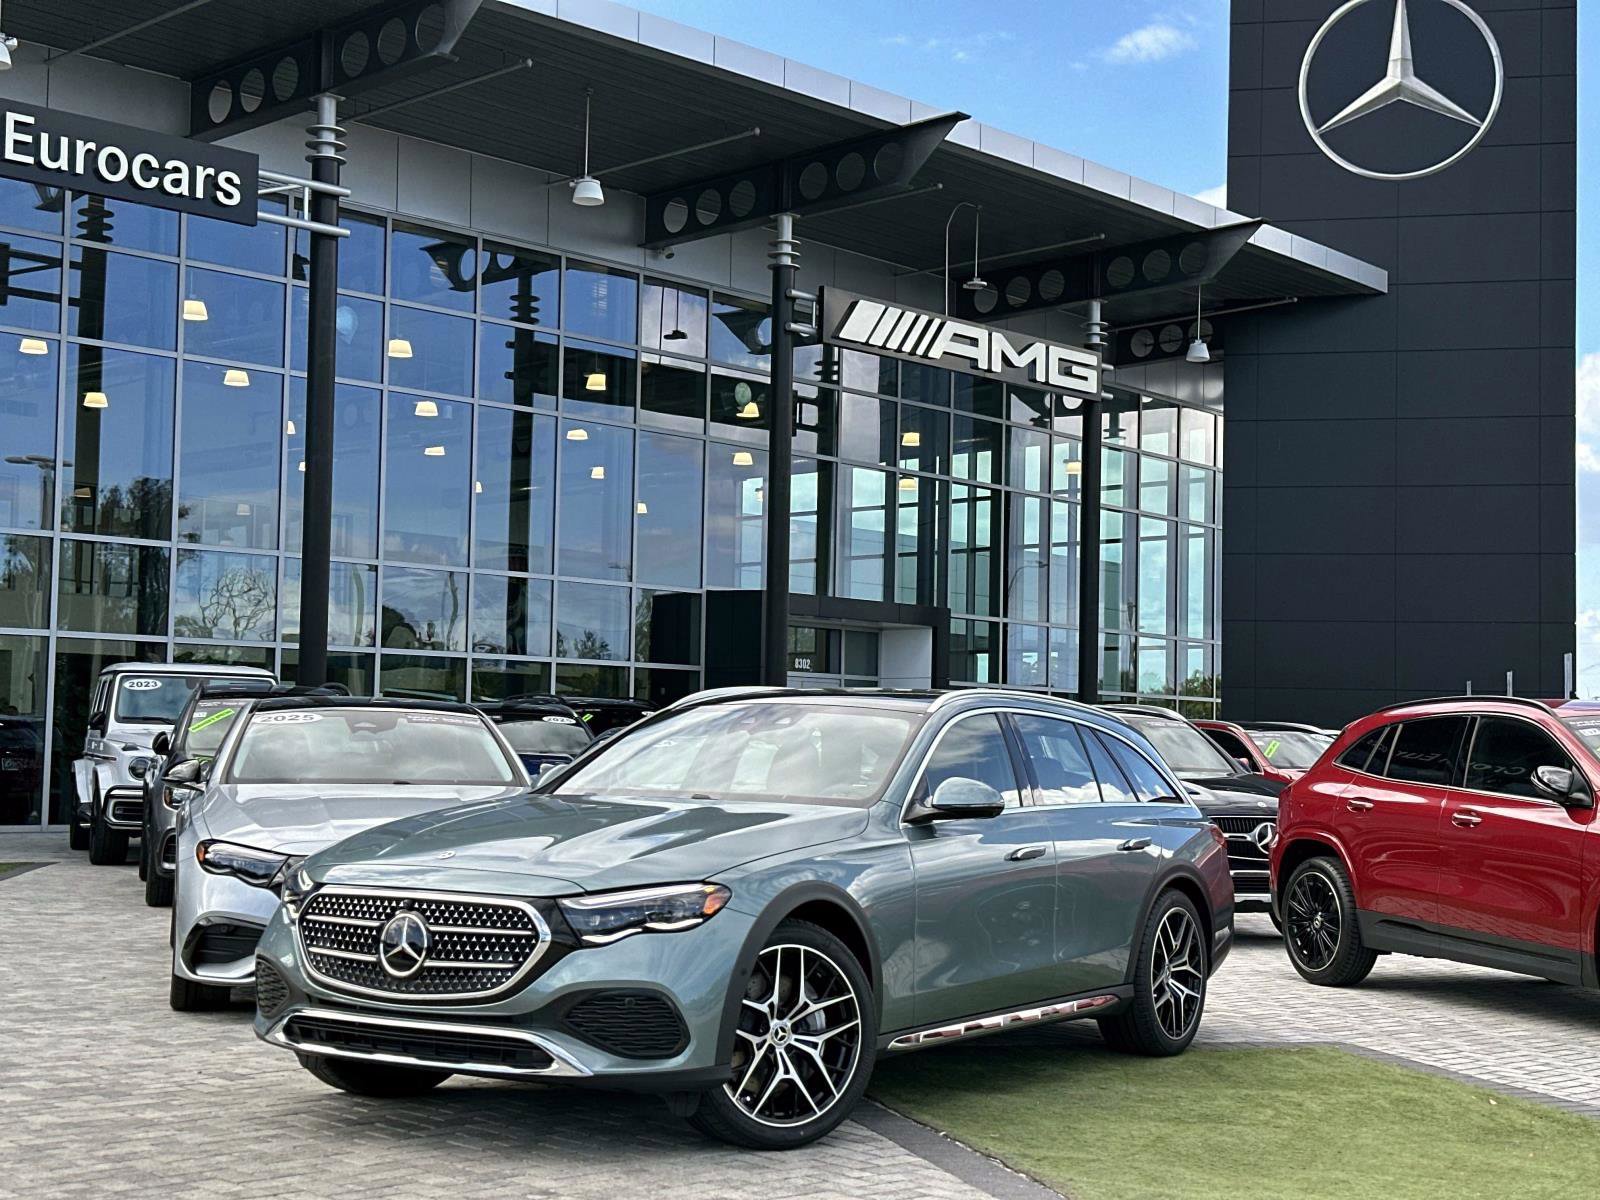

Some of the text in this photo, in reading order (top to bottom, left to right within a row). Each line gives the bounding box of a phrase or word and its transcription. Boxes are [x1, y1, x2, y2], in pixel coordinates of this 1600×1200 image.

[4, 111, 241, 206] Eurocars
[928, 320, 1098, 394] AMG
[794, 657, 811, 670] 8302
[260, 714, 315, 722] 2025
